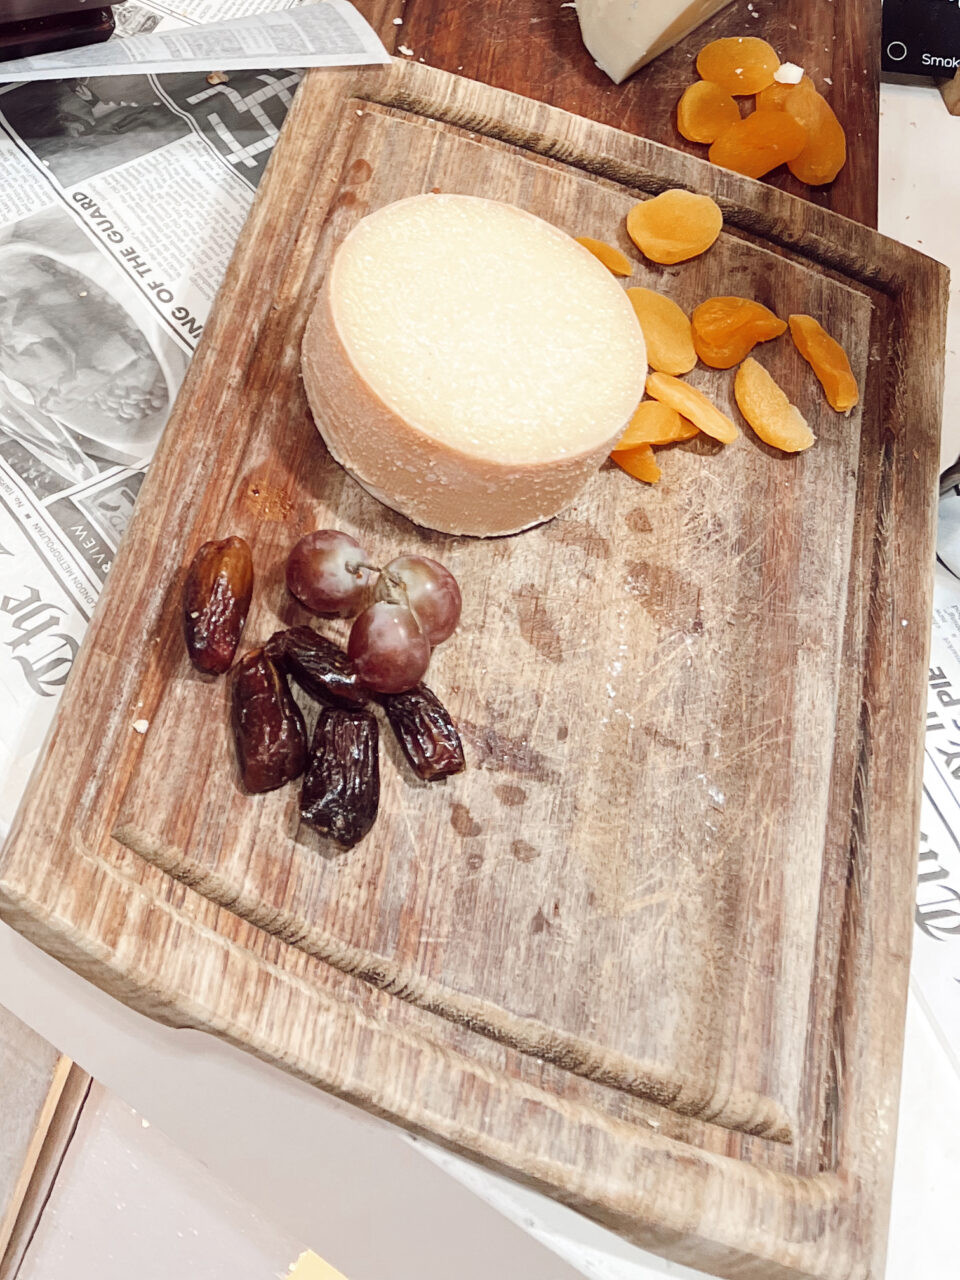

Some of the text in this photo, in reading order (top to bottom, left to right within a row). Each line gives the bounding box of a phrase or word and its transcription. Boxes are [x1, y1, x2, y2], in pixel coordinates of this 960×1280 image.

[921, 53, 960, 68] Smok
[72, 191, 174, 304] GUARD THE OF
[32, 523, 74, 578] METROPOLITAN
[0, 585, 81, 698] The
